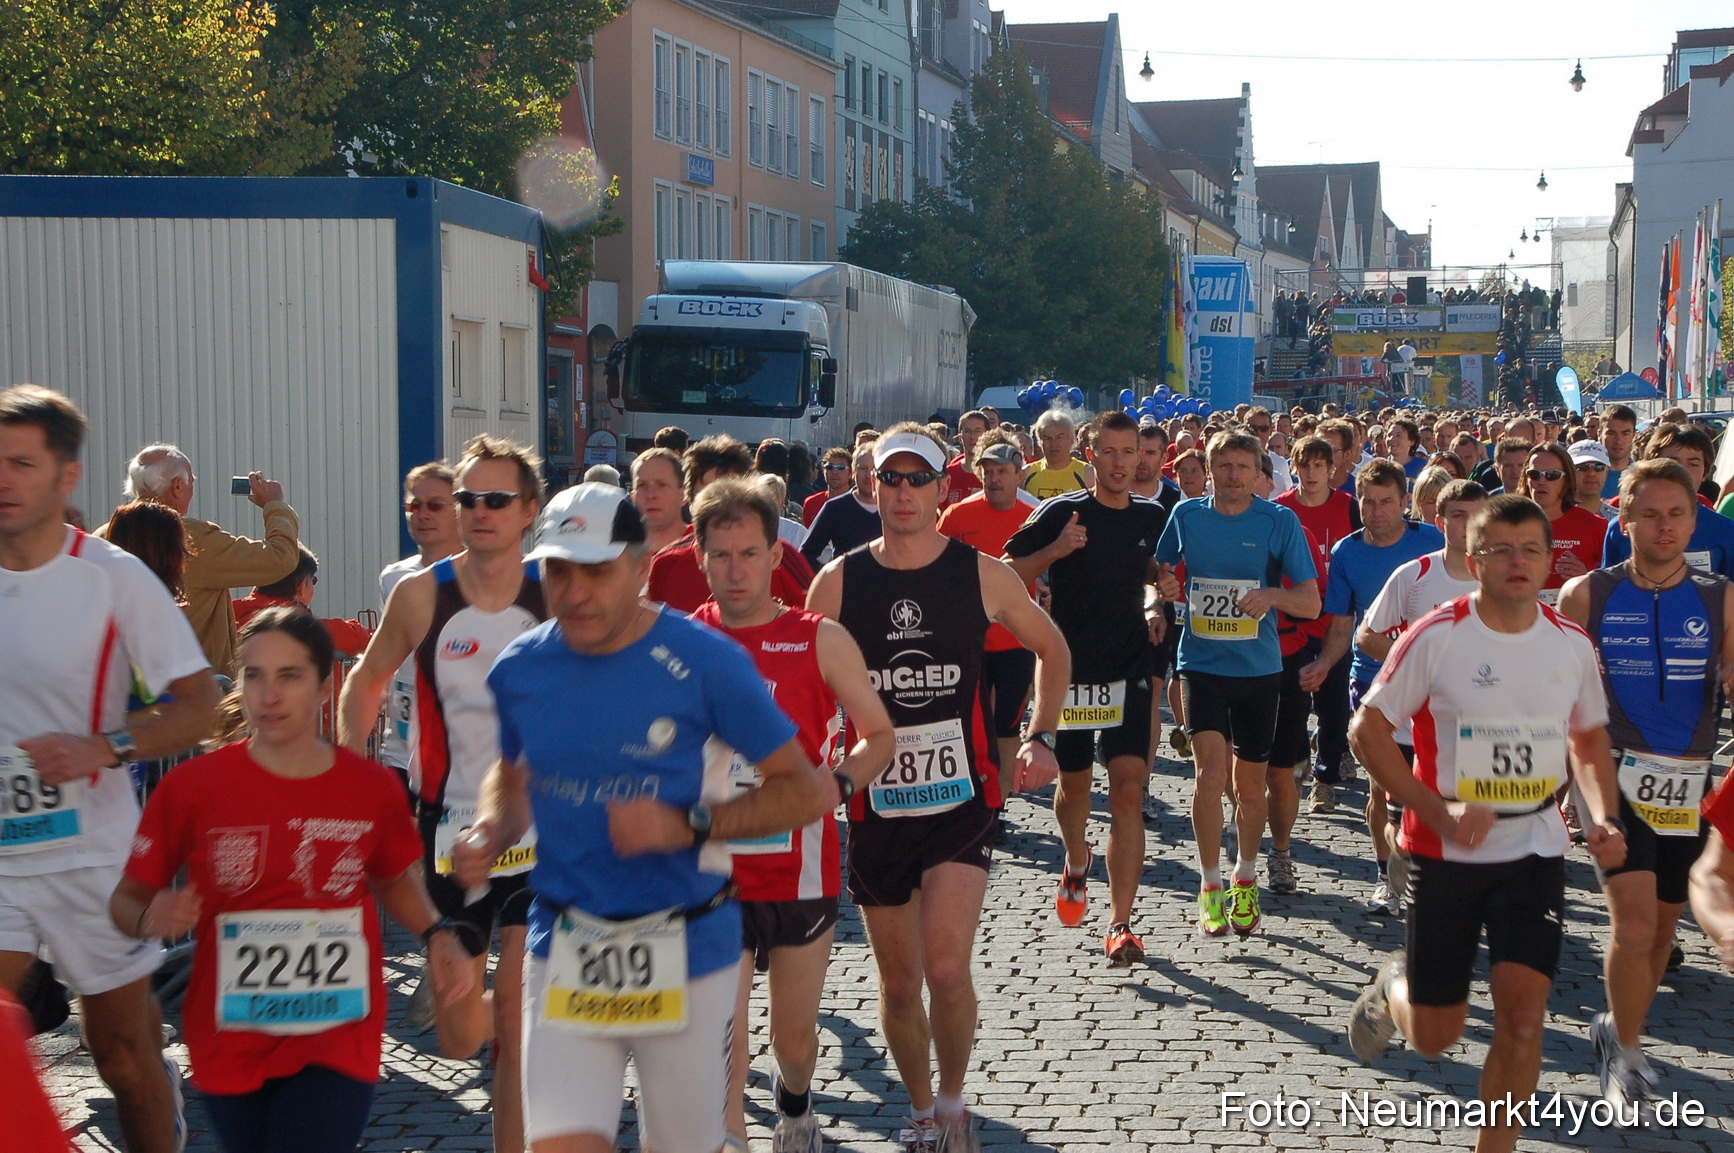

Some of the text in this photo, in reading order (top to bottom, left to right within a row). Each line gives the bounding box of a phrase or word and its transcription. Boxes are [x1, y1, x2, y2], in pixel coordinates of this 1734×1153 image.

[678, 300, 763, 317] BOCK
[1459, 313, 1497, 321] PFLEIDERER
[1209, 315, 1233, 333] dsl
[1357, 313, 1418, 325] BOCK
[1208, 619, 1238, 632] Hans
[887, 631, 904, 640] ebf
[895, 690, 924, 698] SICHERN
[1069, 684, 1111, 706] 118
[1063, 708, 1116, 721] Christian
[896, 734, 921, 744] DERER
[880, 745, 957, 786] 2876
[1492, 743, 1533, 776] 53
[0, 773, 62, 813] 89
[883, 783, 961, 806] Christian
[1475, 779, 1547, 800] Michael
[1638, 774, 1688, 806] 844
[235, 941, 352, 988] 2242
[250, 992, 339, 1020] Carolin
